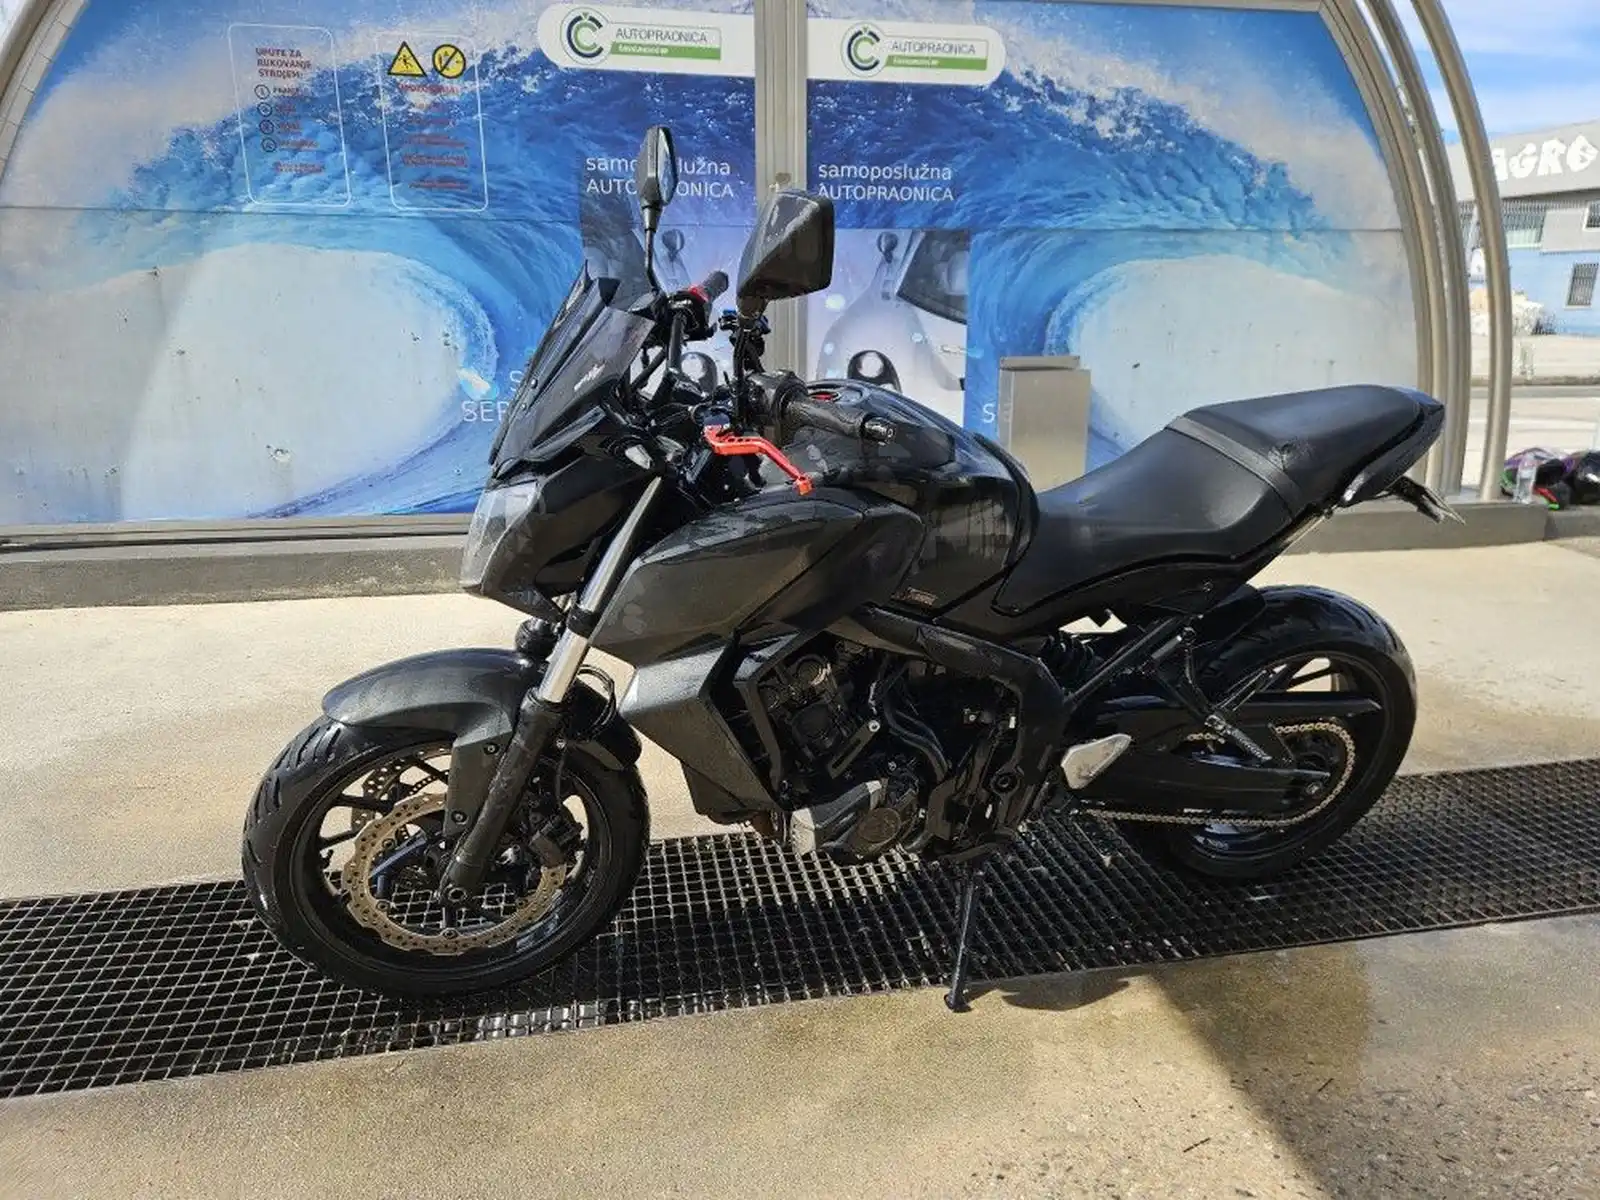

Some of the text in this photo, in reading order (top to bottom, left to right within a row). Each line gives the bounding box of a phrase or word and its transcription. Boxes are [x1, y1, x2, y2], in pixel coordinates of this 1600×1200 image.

[615, 27, 708, 43] AUTOPRAONICA
[288, 49, 302, 58] ZA
[892, 40, 976, 55] AUTOPRAONICA
[257, 59, 312, 69] RUKOVANJE
[586, 156, 731, 176] samolužna
[818, 163, 952, 182] samoposlužna
[586, 178, 734, 198] AUTOONICA
[818, 183, 954, 201] AUTOPRAONICA
